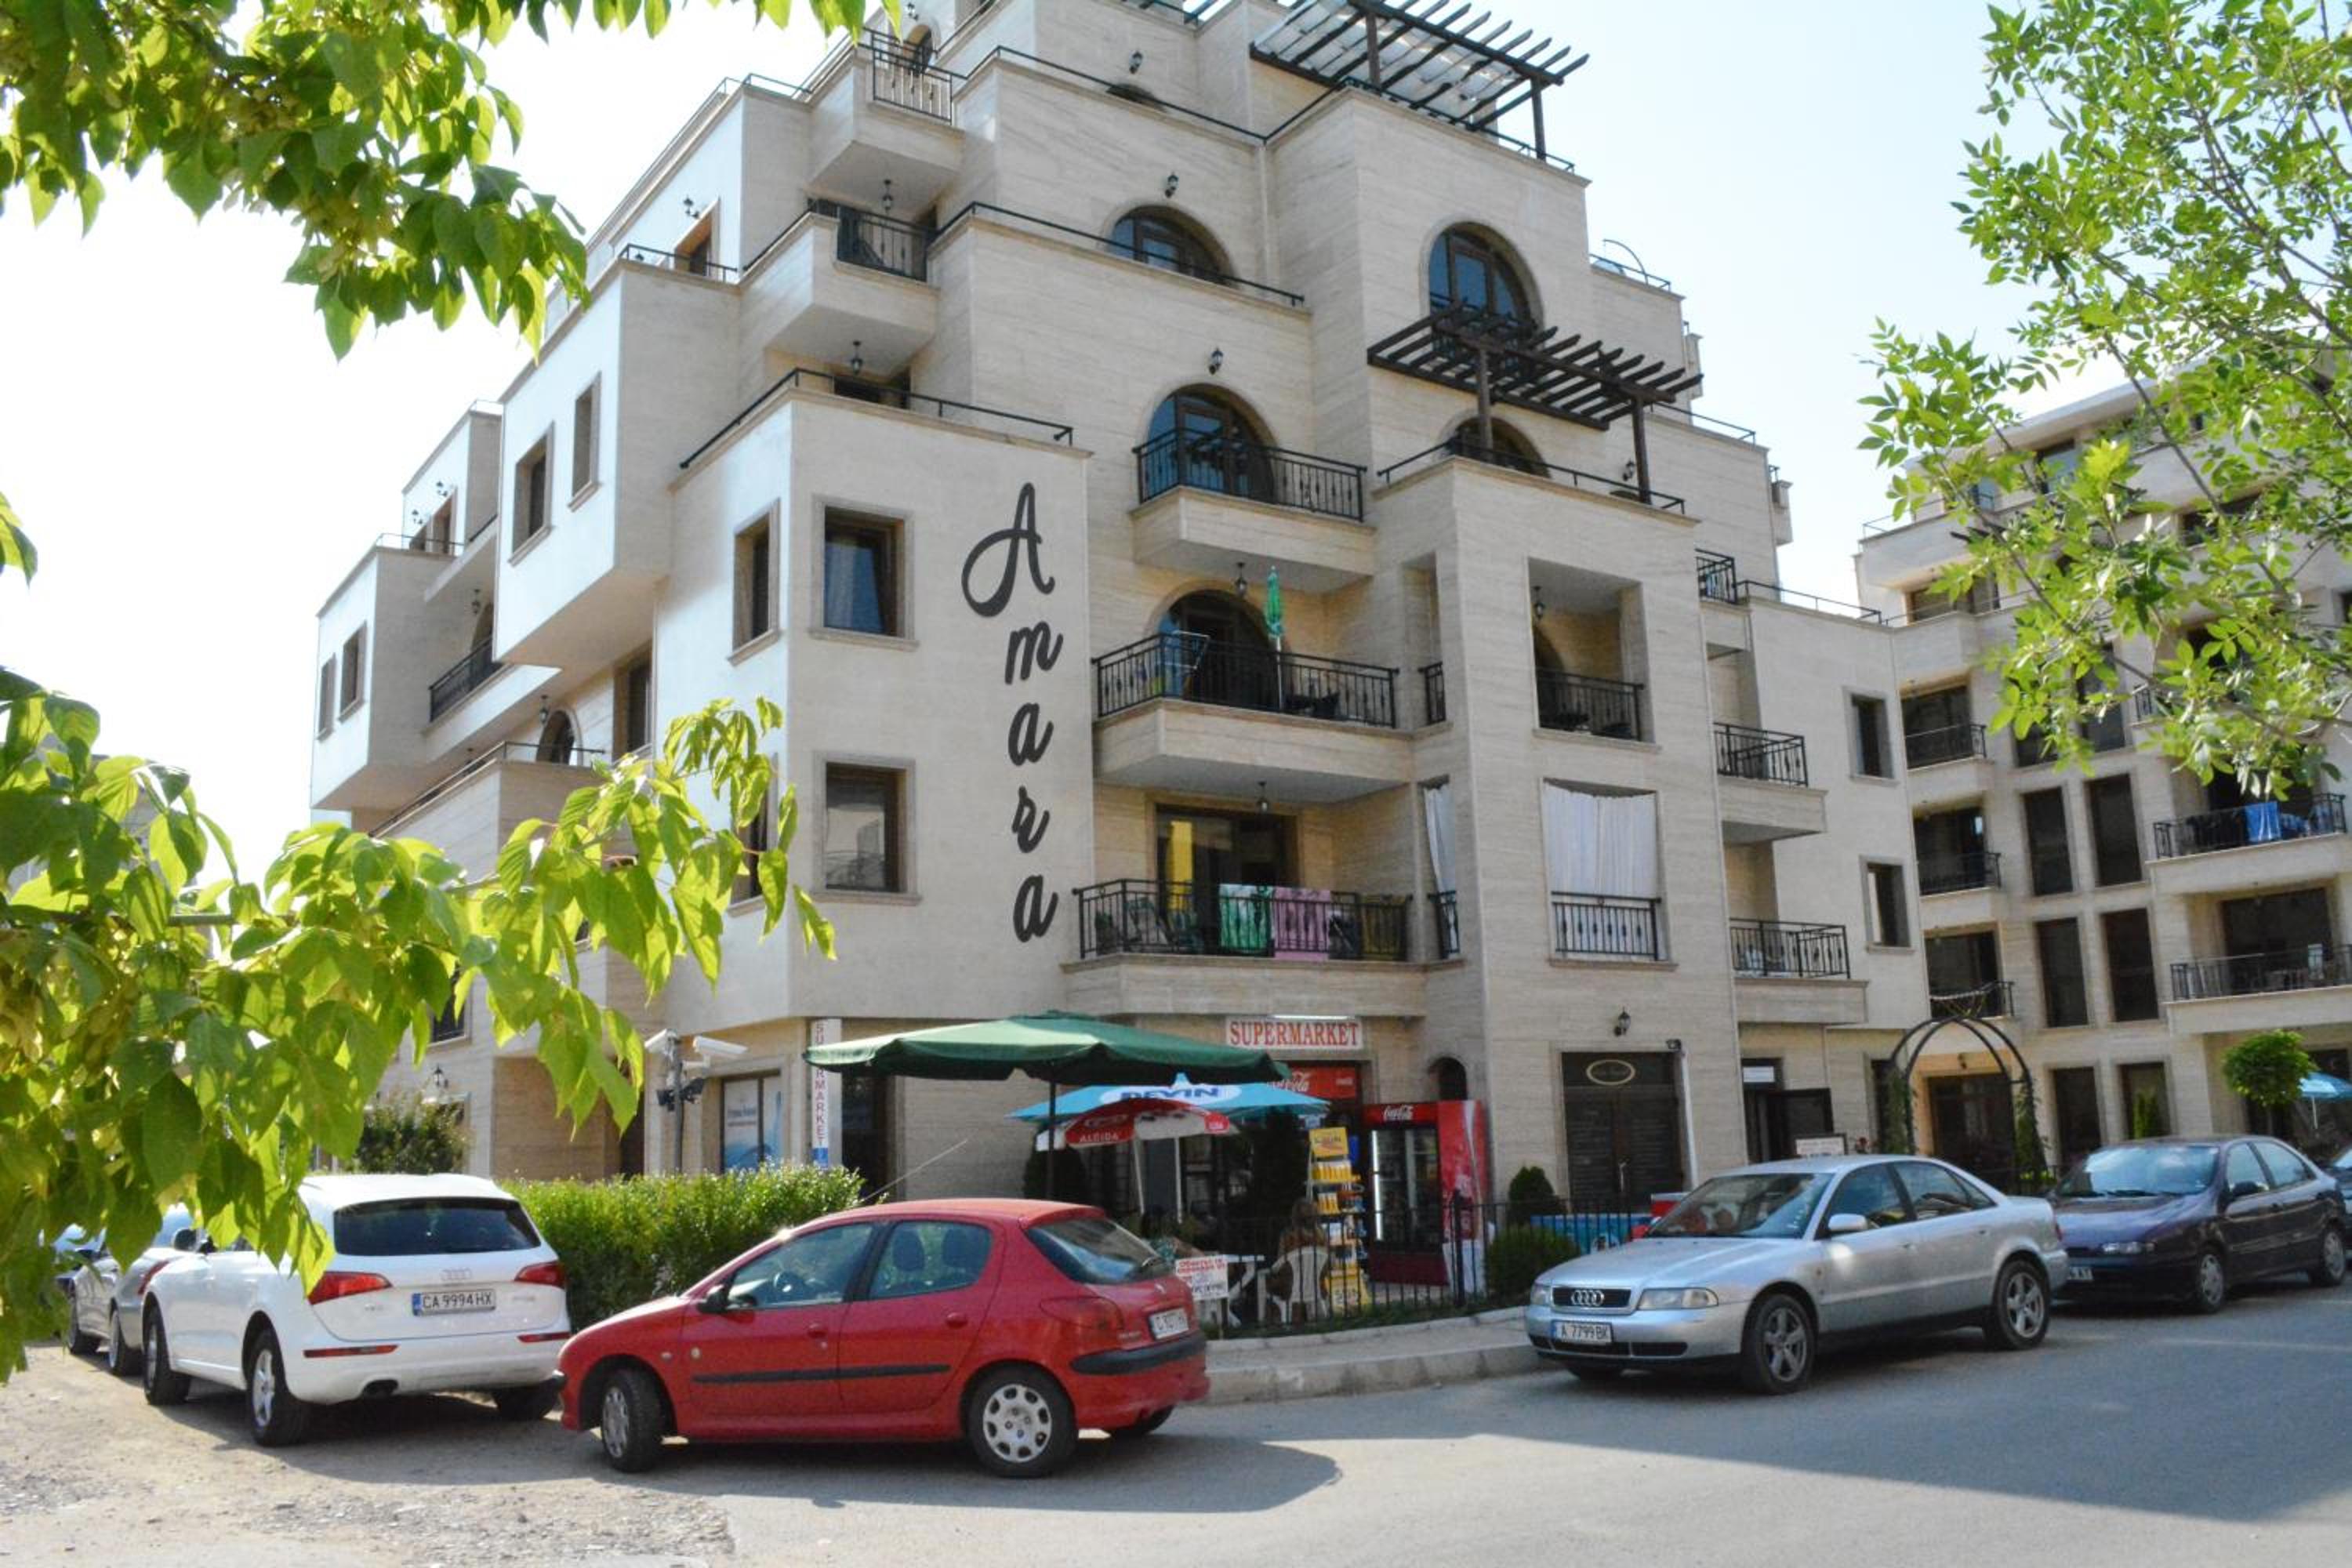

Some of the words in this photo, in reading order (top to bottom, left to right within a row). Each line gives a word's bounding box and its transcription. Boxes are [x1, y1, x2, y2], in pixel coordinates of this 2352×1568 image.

[961, 481, 1063, 943] Amara
[1229, 1021, 1359, 1046] SUPERMARKET
[815, 1022, 826, 1145] SURMARKET
[1120, 1087, 1219, 1100] DEVIN
